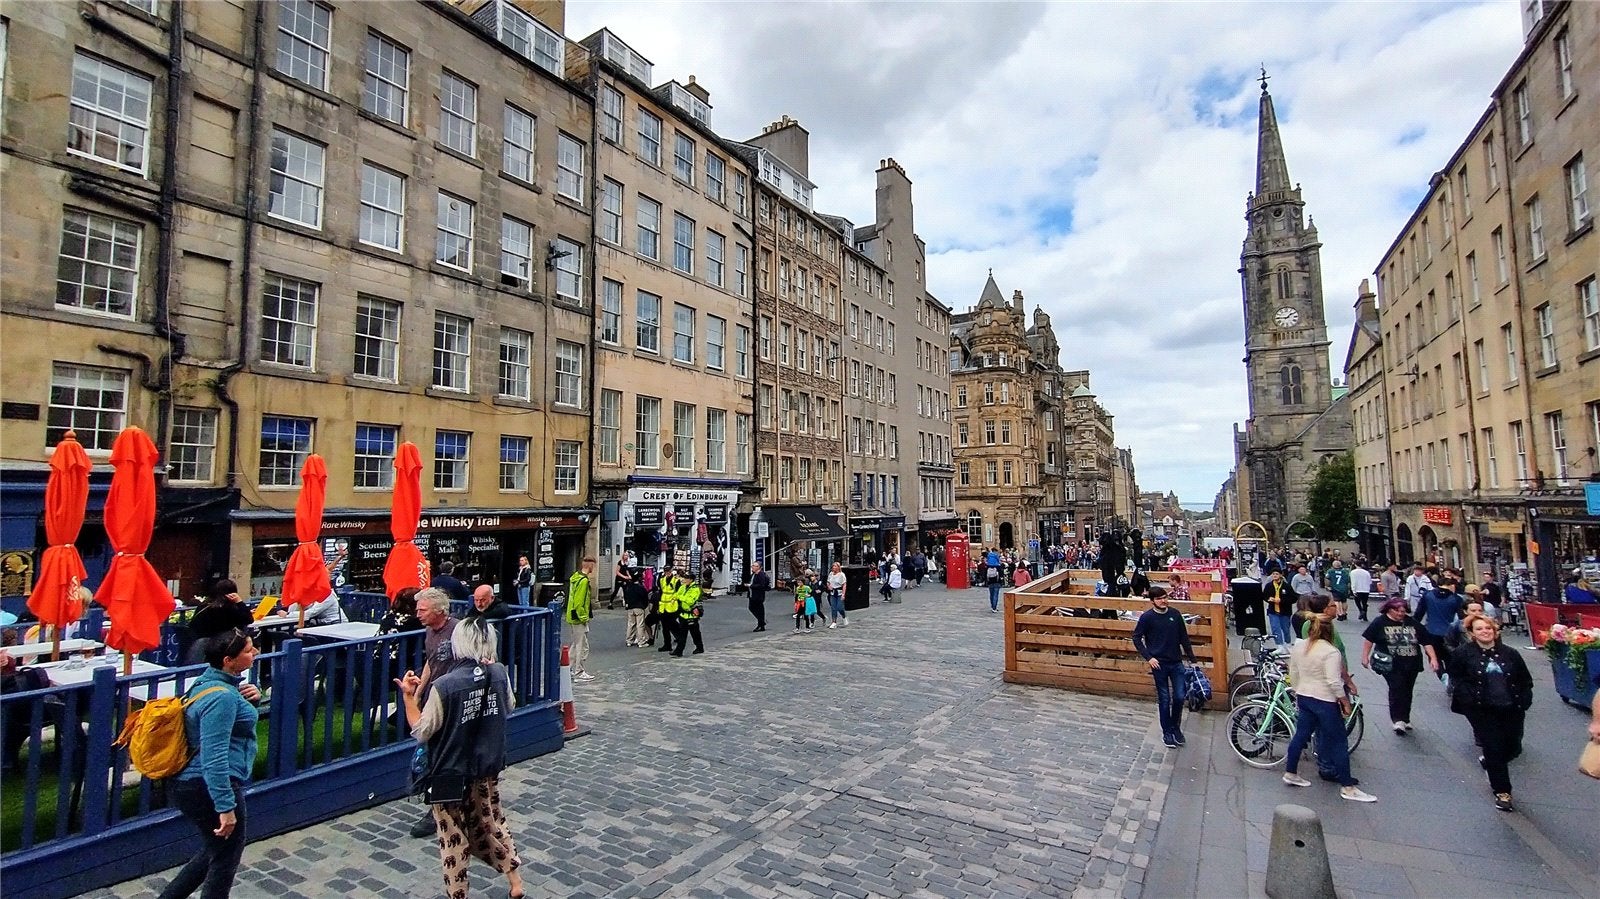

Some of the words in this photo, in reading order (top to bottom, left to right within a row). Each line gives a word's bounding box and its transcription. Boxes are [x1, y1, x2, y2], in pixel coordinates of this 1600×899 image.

[643, 491, 670, 500] CREST
[673, 492, 684, 500] OF
[686, 493, 728, 501] EDINBURGH
[321, 521, 339, 529] Rare
[340, 520, 367, 530] Whisky
[431, 515, 474, 530] Whisky
[476, 515, 500, 527] Trail
[527, 516, 545, 524] Whisky
[436, 537, 458, 547] Single
[472, 535, 496, 545] Whisky
[358, 541, 392, 550] Scottish
[468, 543, 500, 553] Specialist
[363, 551, 387, 559] Beers
[1335, 575, 1342, 585] 7
[463, 696, 482, 708] TAKES
[487, 693, 497, 701] NE
[488, 700, 497, 708] TO
[461, 712, 476, 724] SAVE
[483, 708, 499, 717] LIFE
